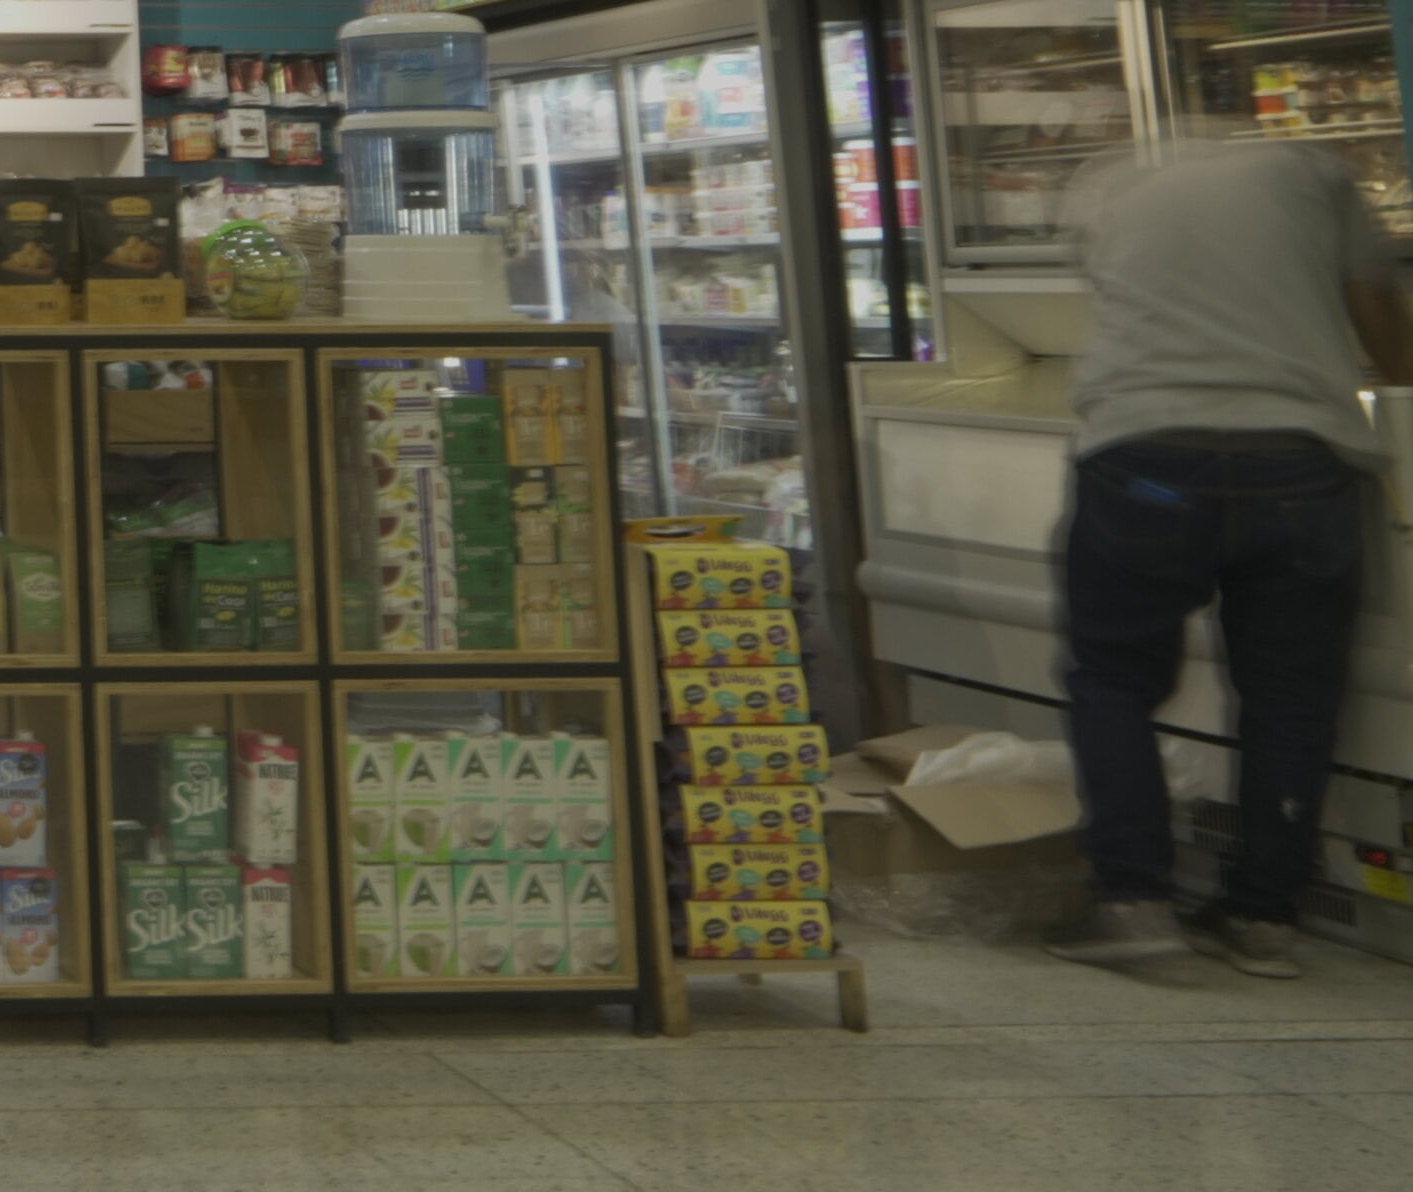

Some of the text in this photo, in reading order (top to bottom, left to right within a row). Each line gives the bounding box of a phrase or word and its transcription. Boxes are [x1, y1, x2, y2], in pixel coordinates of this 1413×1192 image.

[357, 752, 383, 784] A
[407, 751, 437, 783] A
[461, 747, 490, 779] A
[513, 748, 543, 780] A
[568, 748, 598, 779] A
[169, 777, 228, 824] Silk
[252, 885, 291, 902] NATRUE
[354, 877, 383, 907] A
[410, 875, 440, 906] A
[467, 873, 497, 906] A
[522, 873, 552, 904] A
[581, 874, 609, 904] A
[126, 903, 186, 954] Silk
[185, 903, 244, 953] Silk
